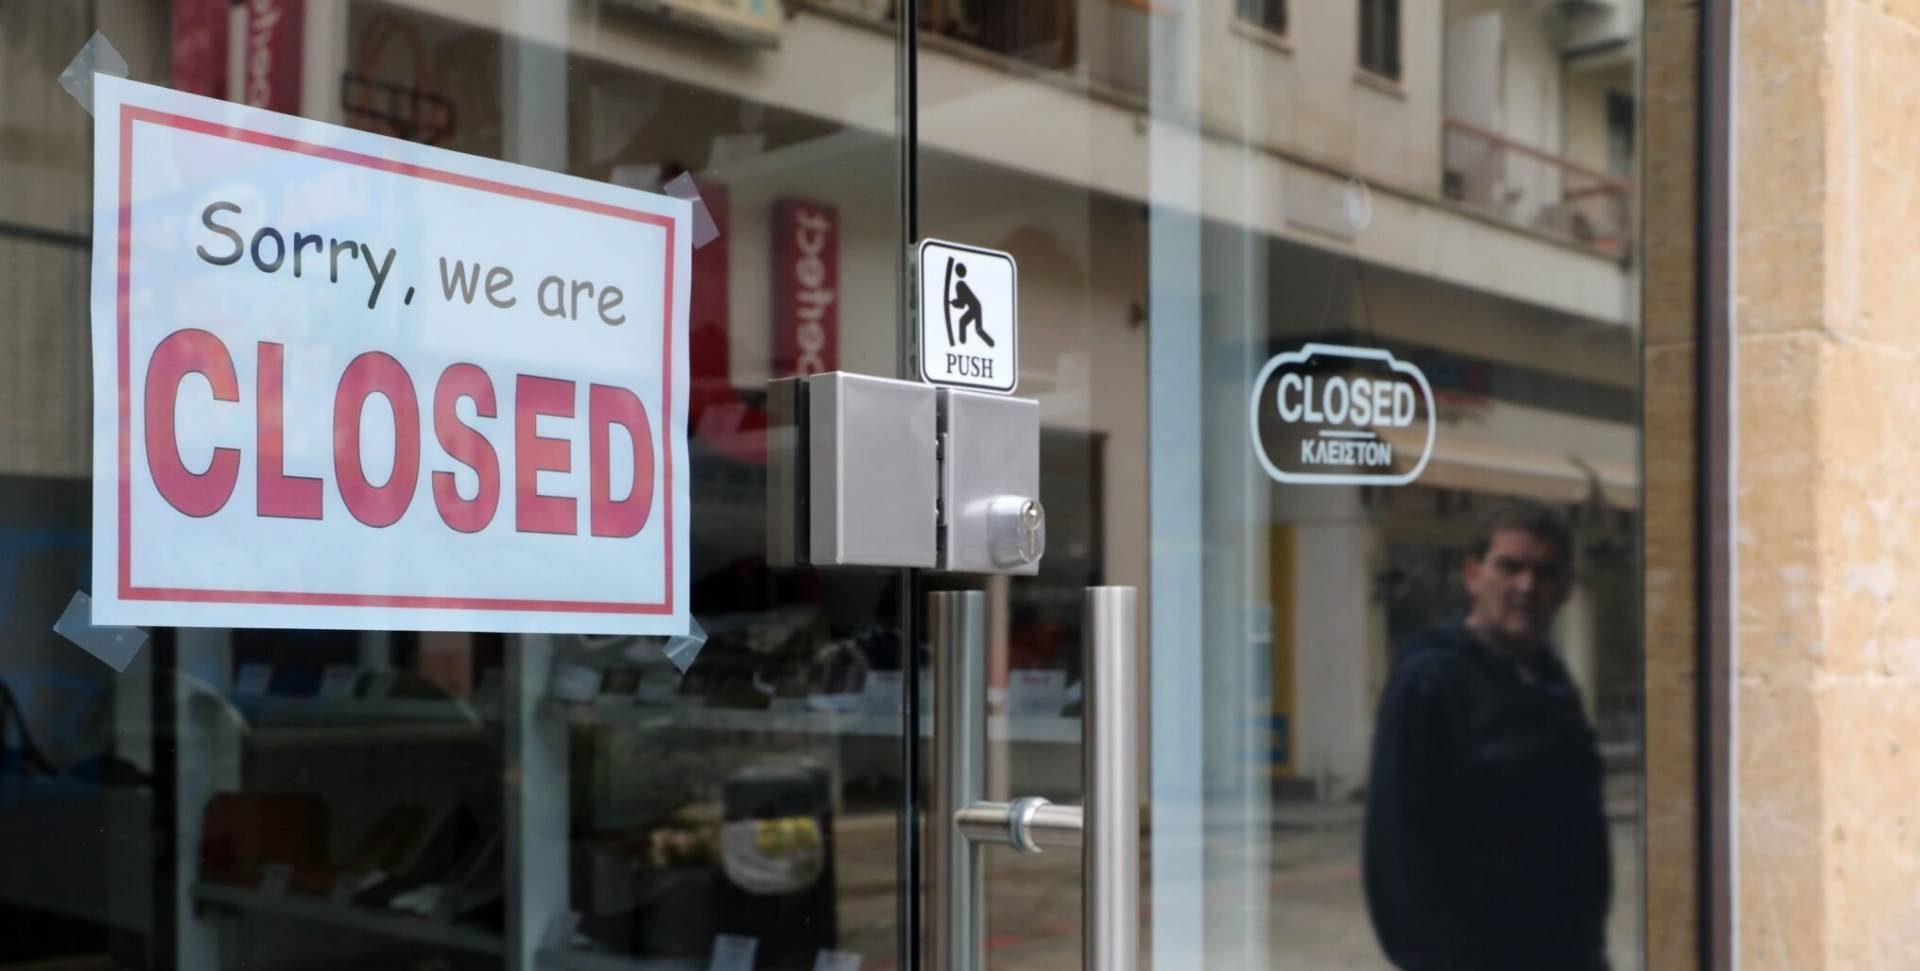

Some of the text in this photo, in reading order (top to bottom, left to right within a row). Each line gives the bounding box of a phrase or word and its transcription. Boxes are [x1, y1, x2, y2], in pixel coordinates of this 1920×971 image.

[197, 201, 626, 326] Sorry, we are
[946, 353, 994, 379] PUSH
[1277, 372, 1416, 427] CLOSED
[144, 328, 655, 539] CLOSED
[1301, 439, 1392, 467] ΚΛΕΙΣΤΟΝ
